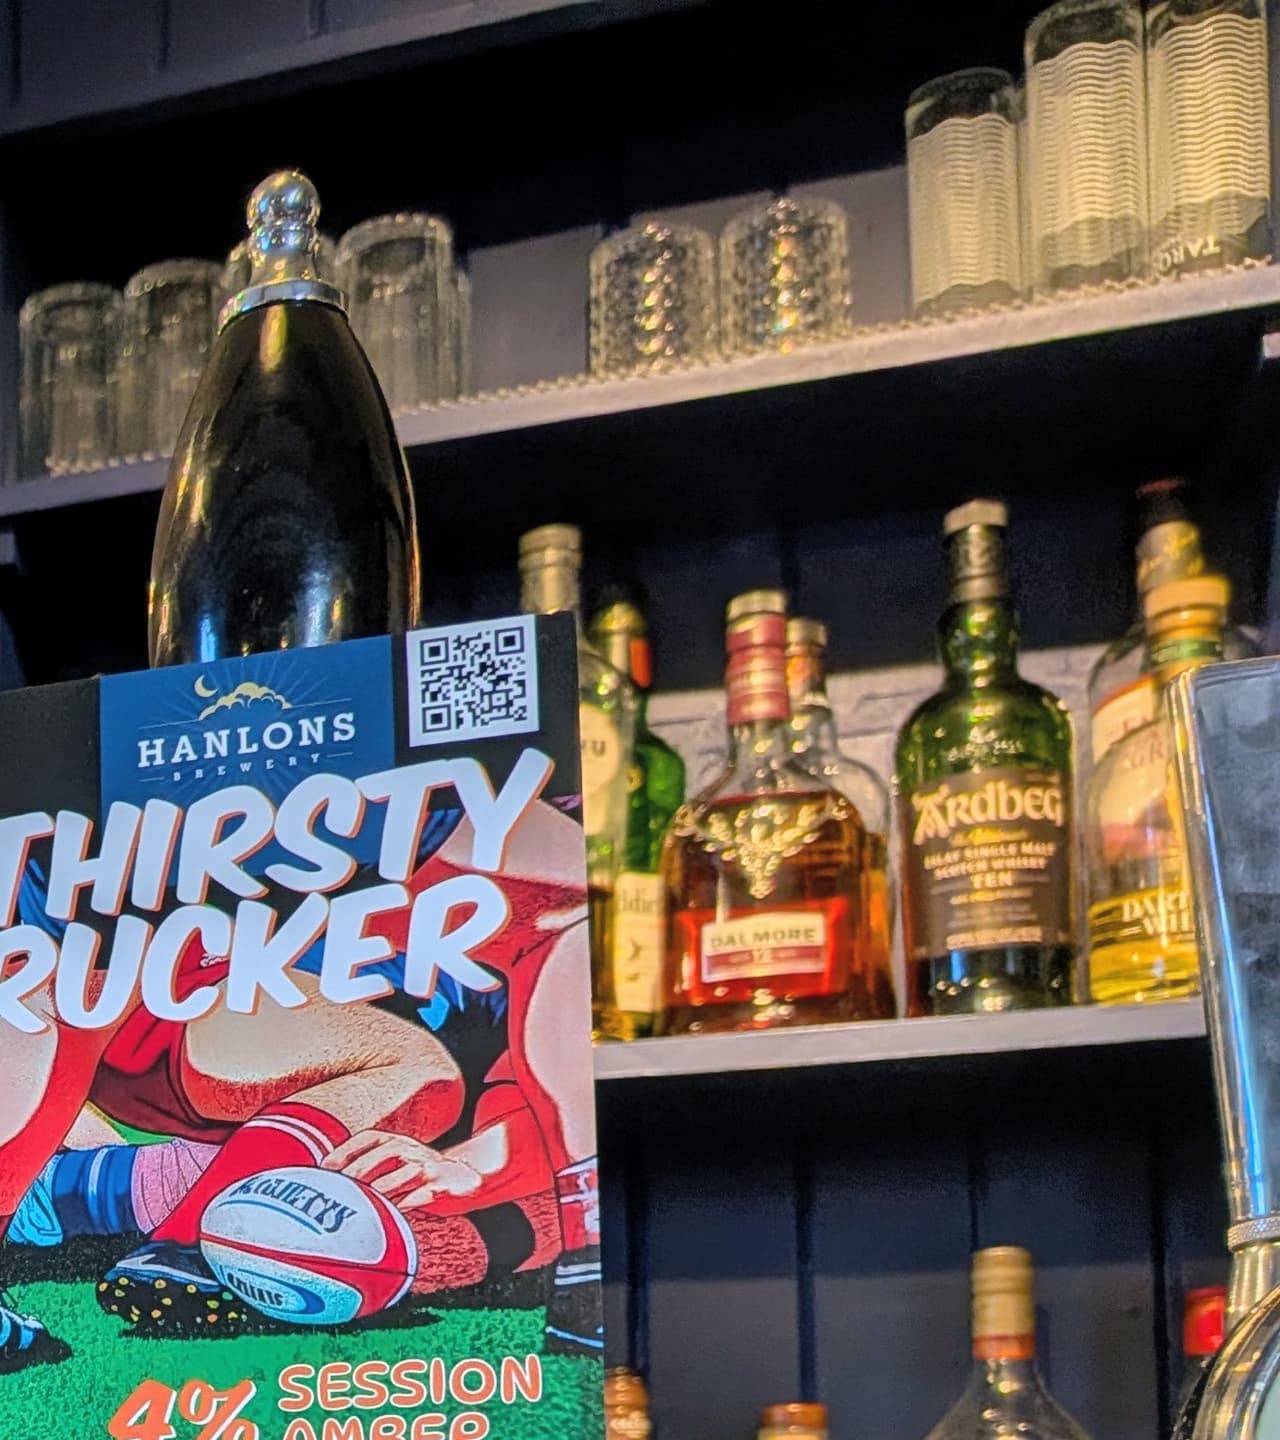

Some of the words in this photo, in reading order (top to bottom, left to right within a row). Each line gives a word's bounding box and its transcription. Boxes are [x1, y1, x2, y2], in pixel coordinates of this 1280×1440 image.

[137, 712, 356, 769] HANLONS
[173, 753, 321, 782] BREWERY
[971, 870, 1014, 889] TEN
[1122, 891, 1192, 922] DART
[710, 927, 817, 950] DALMORE
[278, 1353, 543, 1413] SESSION
